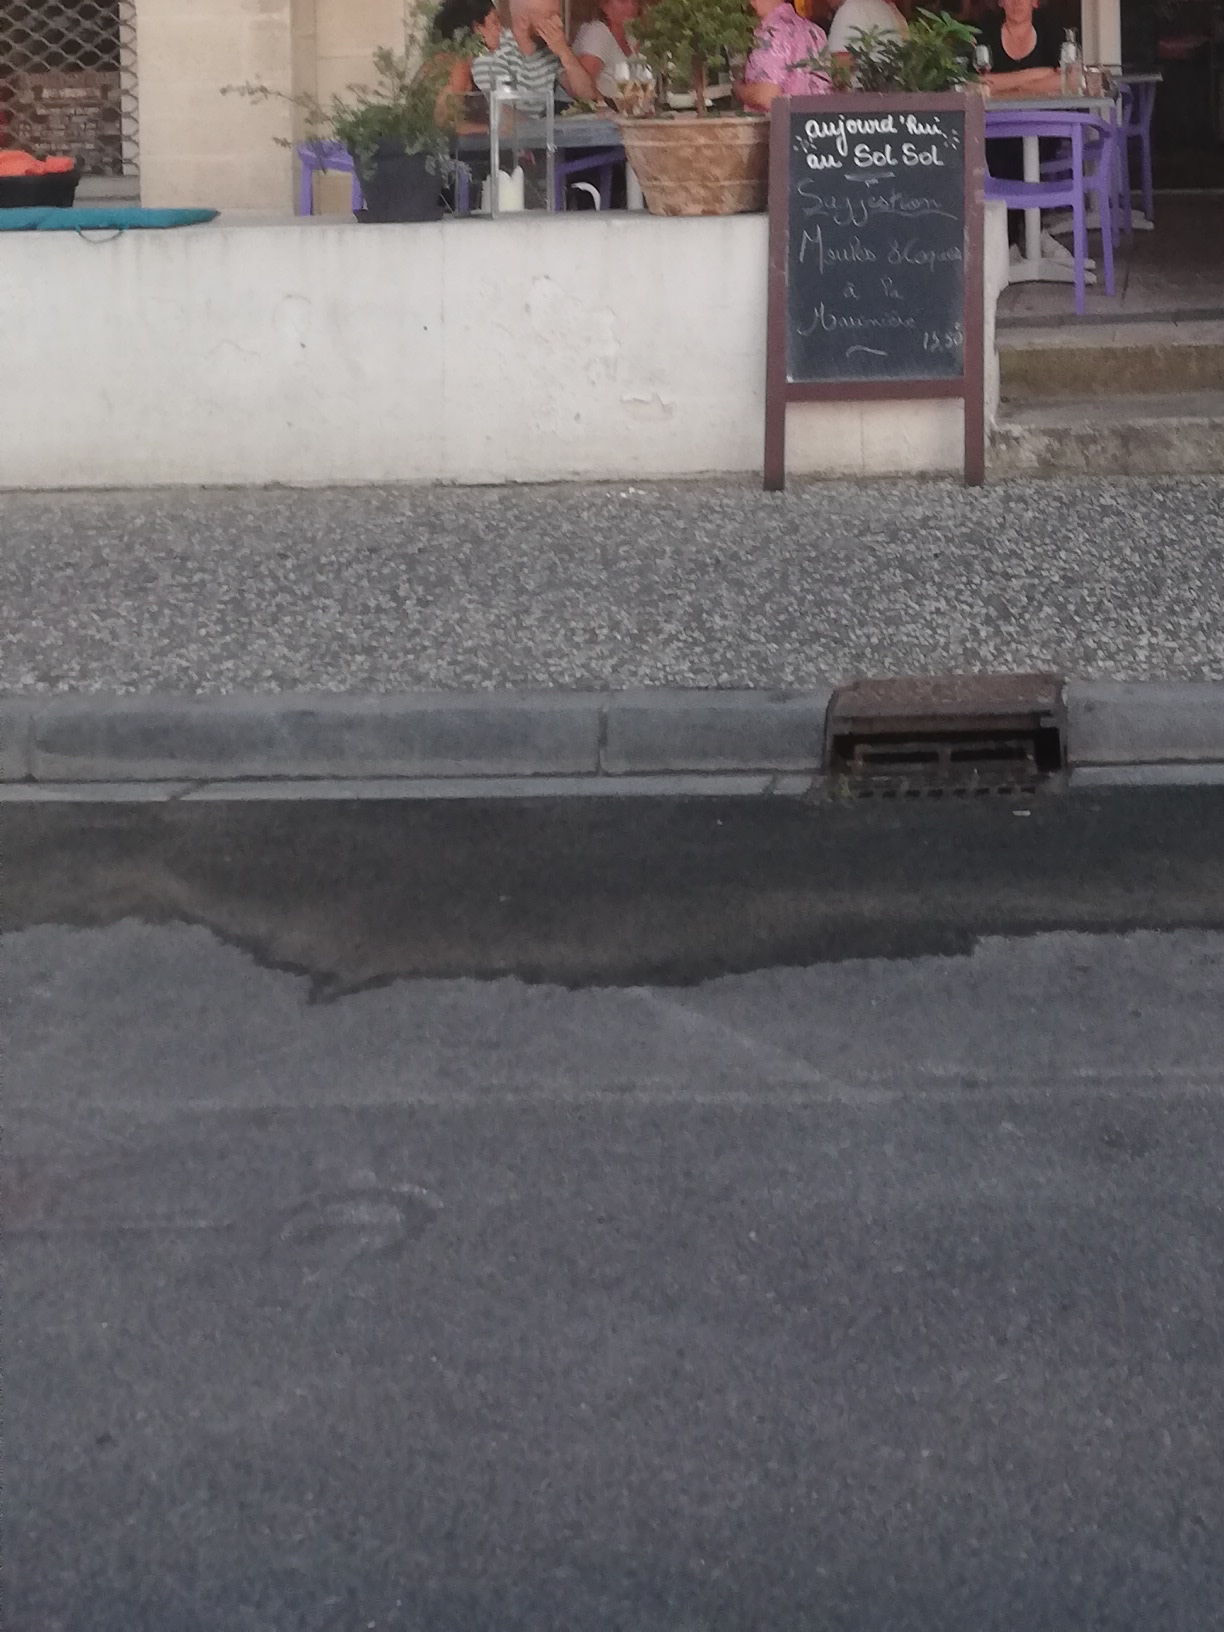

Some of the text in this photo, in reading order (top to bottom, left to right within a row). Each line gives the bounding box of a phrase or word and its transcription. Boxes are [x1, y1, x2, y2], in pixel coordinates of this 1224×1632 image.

[807, 143, 945, 170] au Sol Sol
